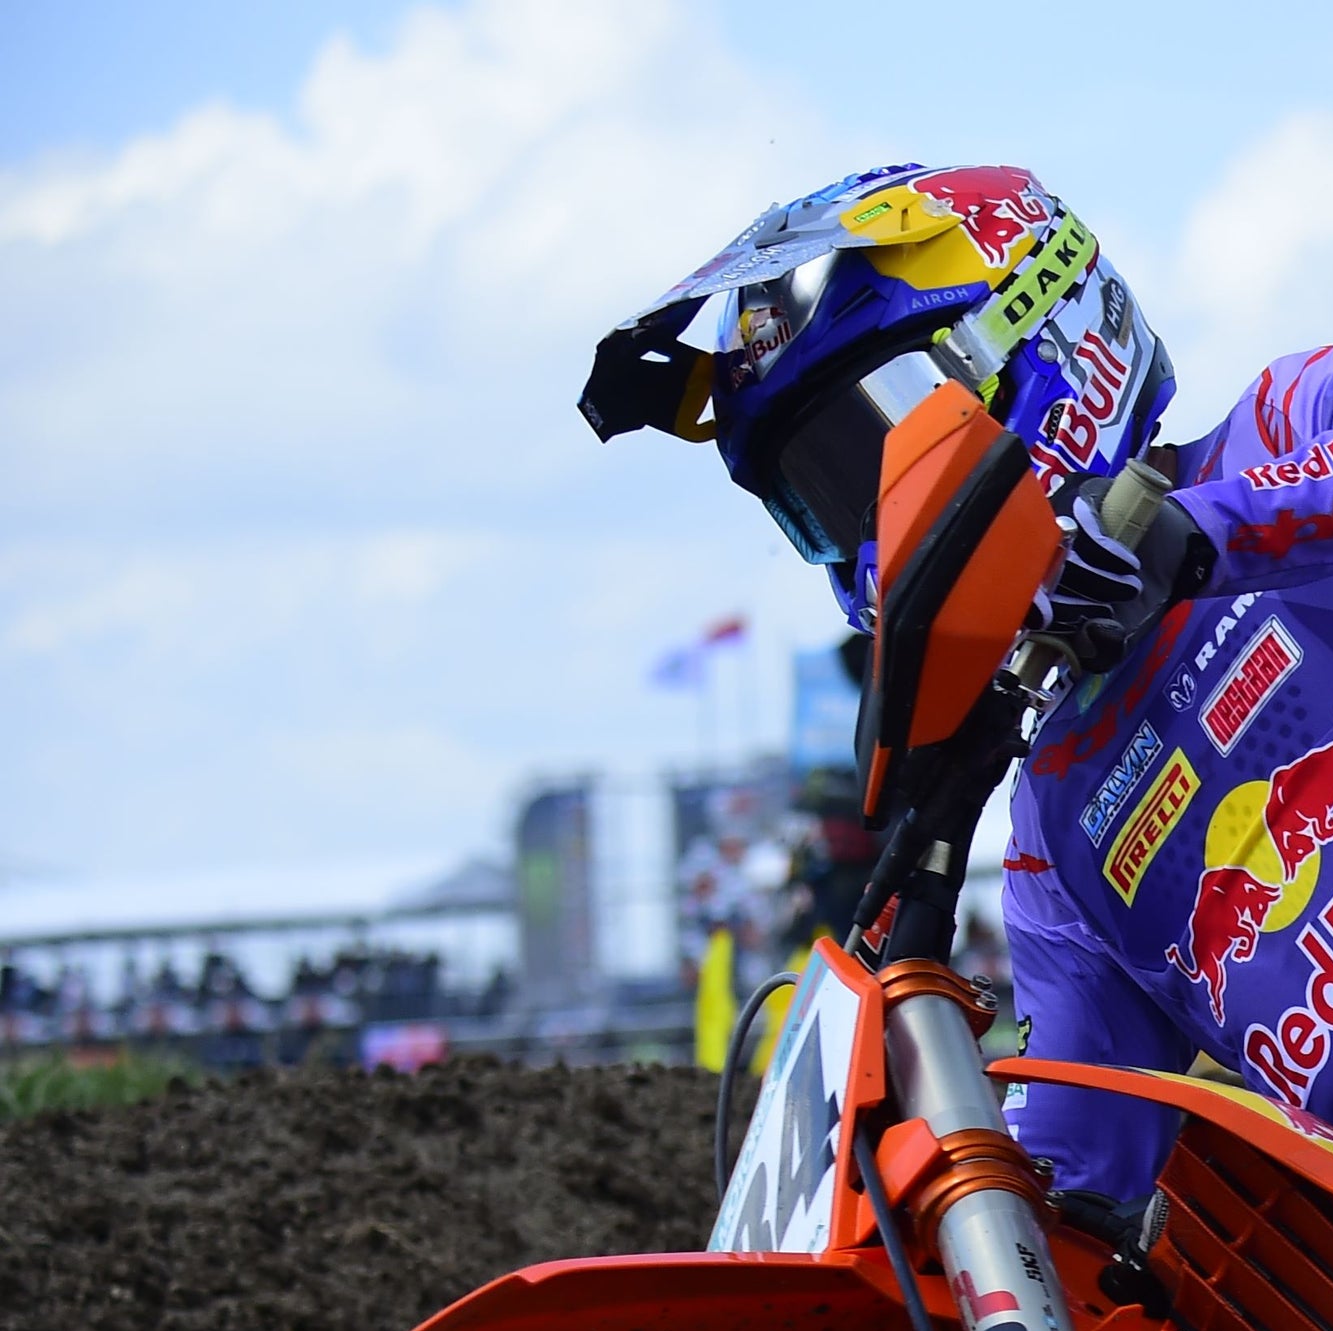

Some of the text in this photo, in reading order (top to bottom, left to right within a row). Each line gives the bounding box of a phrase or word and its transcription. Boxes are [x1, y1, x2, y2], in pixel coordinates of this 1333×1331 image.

[911, 287, 969, 309] AIROH
[1105, 284, 1126, 331] HVG
[752, 322, 792, 362] Bull
[1056, 330, 1127, 465] Bull
[1244, 445, 1330, 489] Red
[1083, 725, 1159, 838] GALVIN
[1110, 763, 1191, 895] PIRELLI
[1015, 1242, 1045, 1283] SKF
